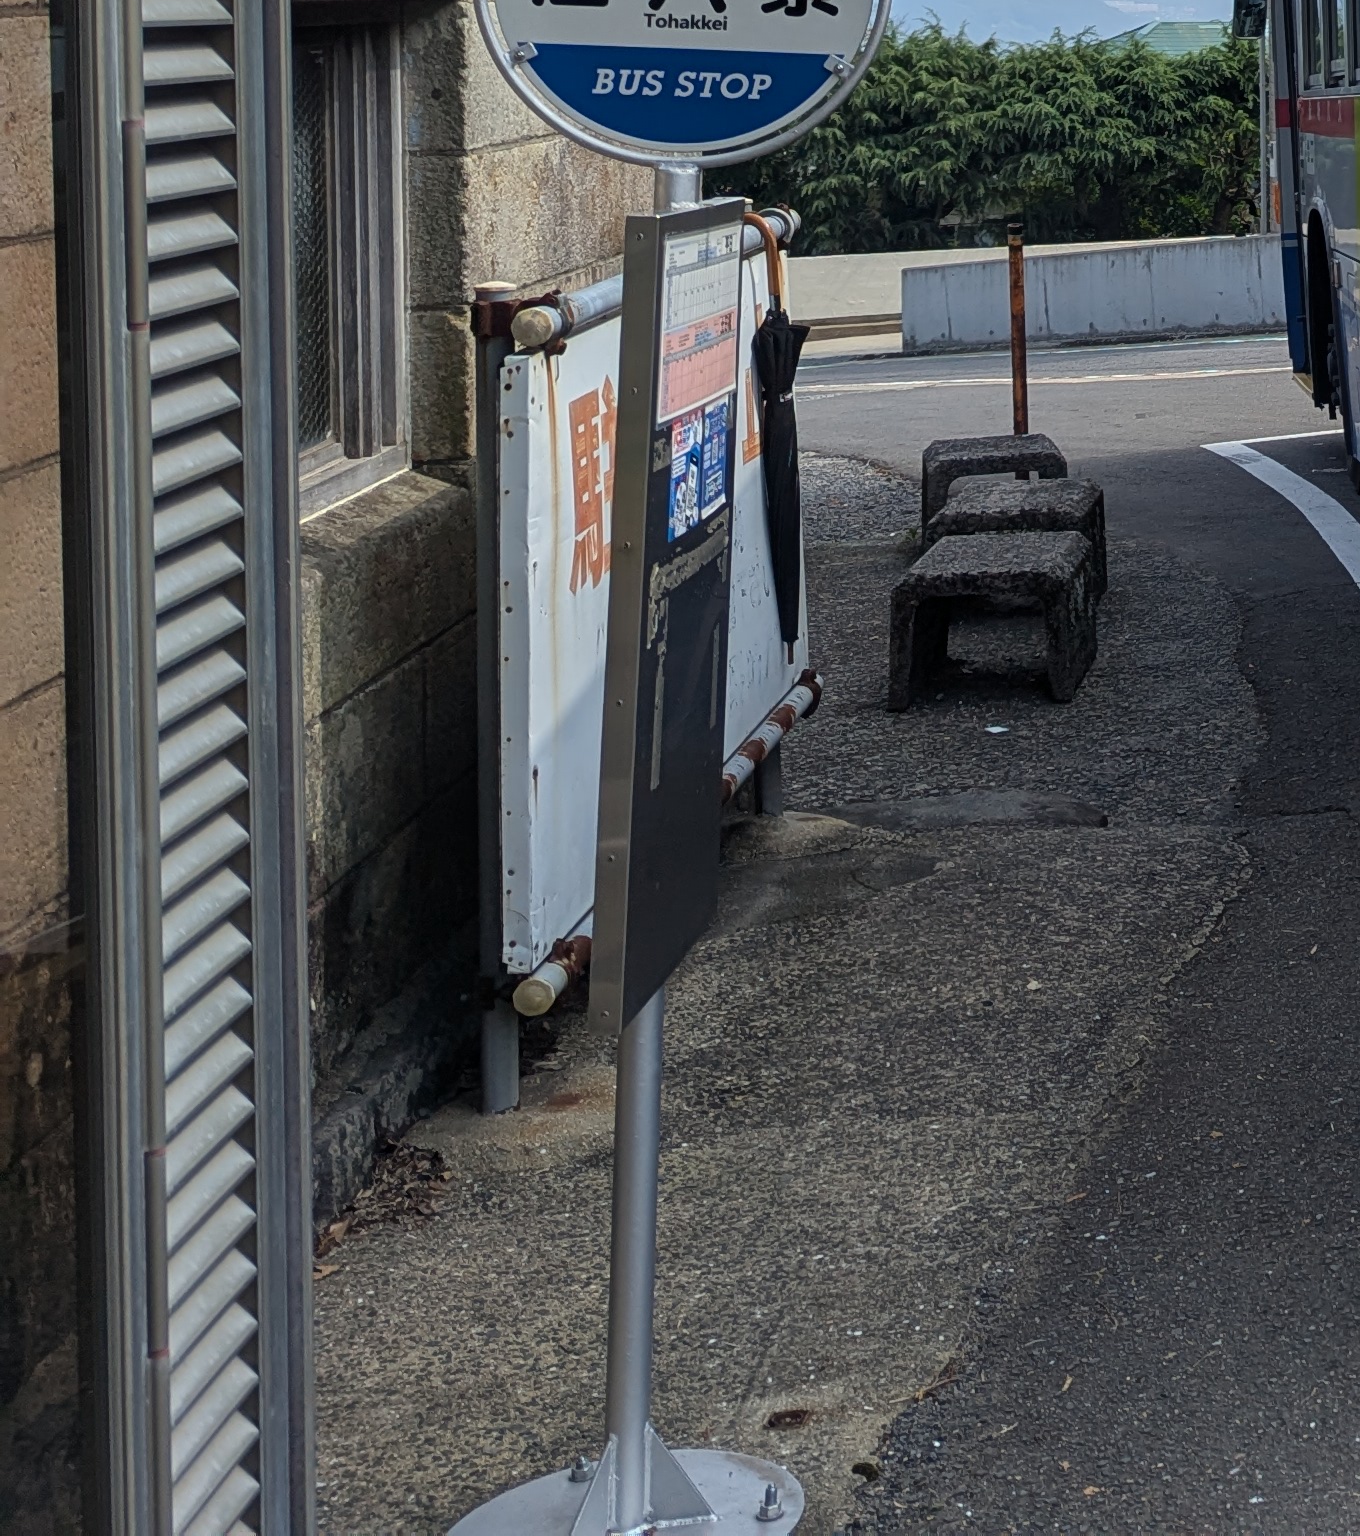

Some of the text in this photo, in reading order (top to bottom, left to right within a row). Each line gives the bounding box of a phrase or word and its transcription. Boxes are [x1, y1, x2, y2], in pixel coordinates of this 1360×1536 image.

[643, 13, 728, 32] Tohakkei
[592, 68, 773, 101] BUS STOP
